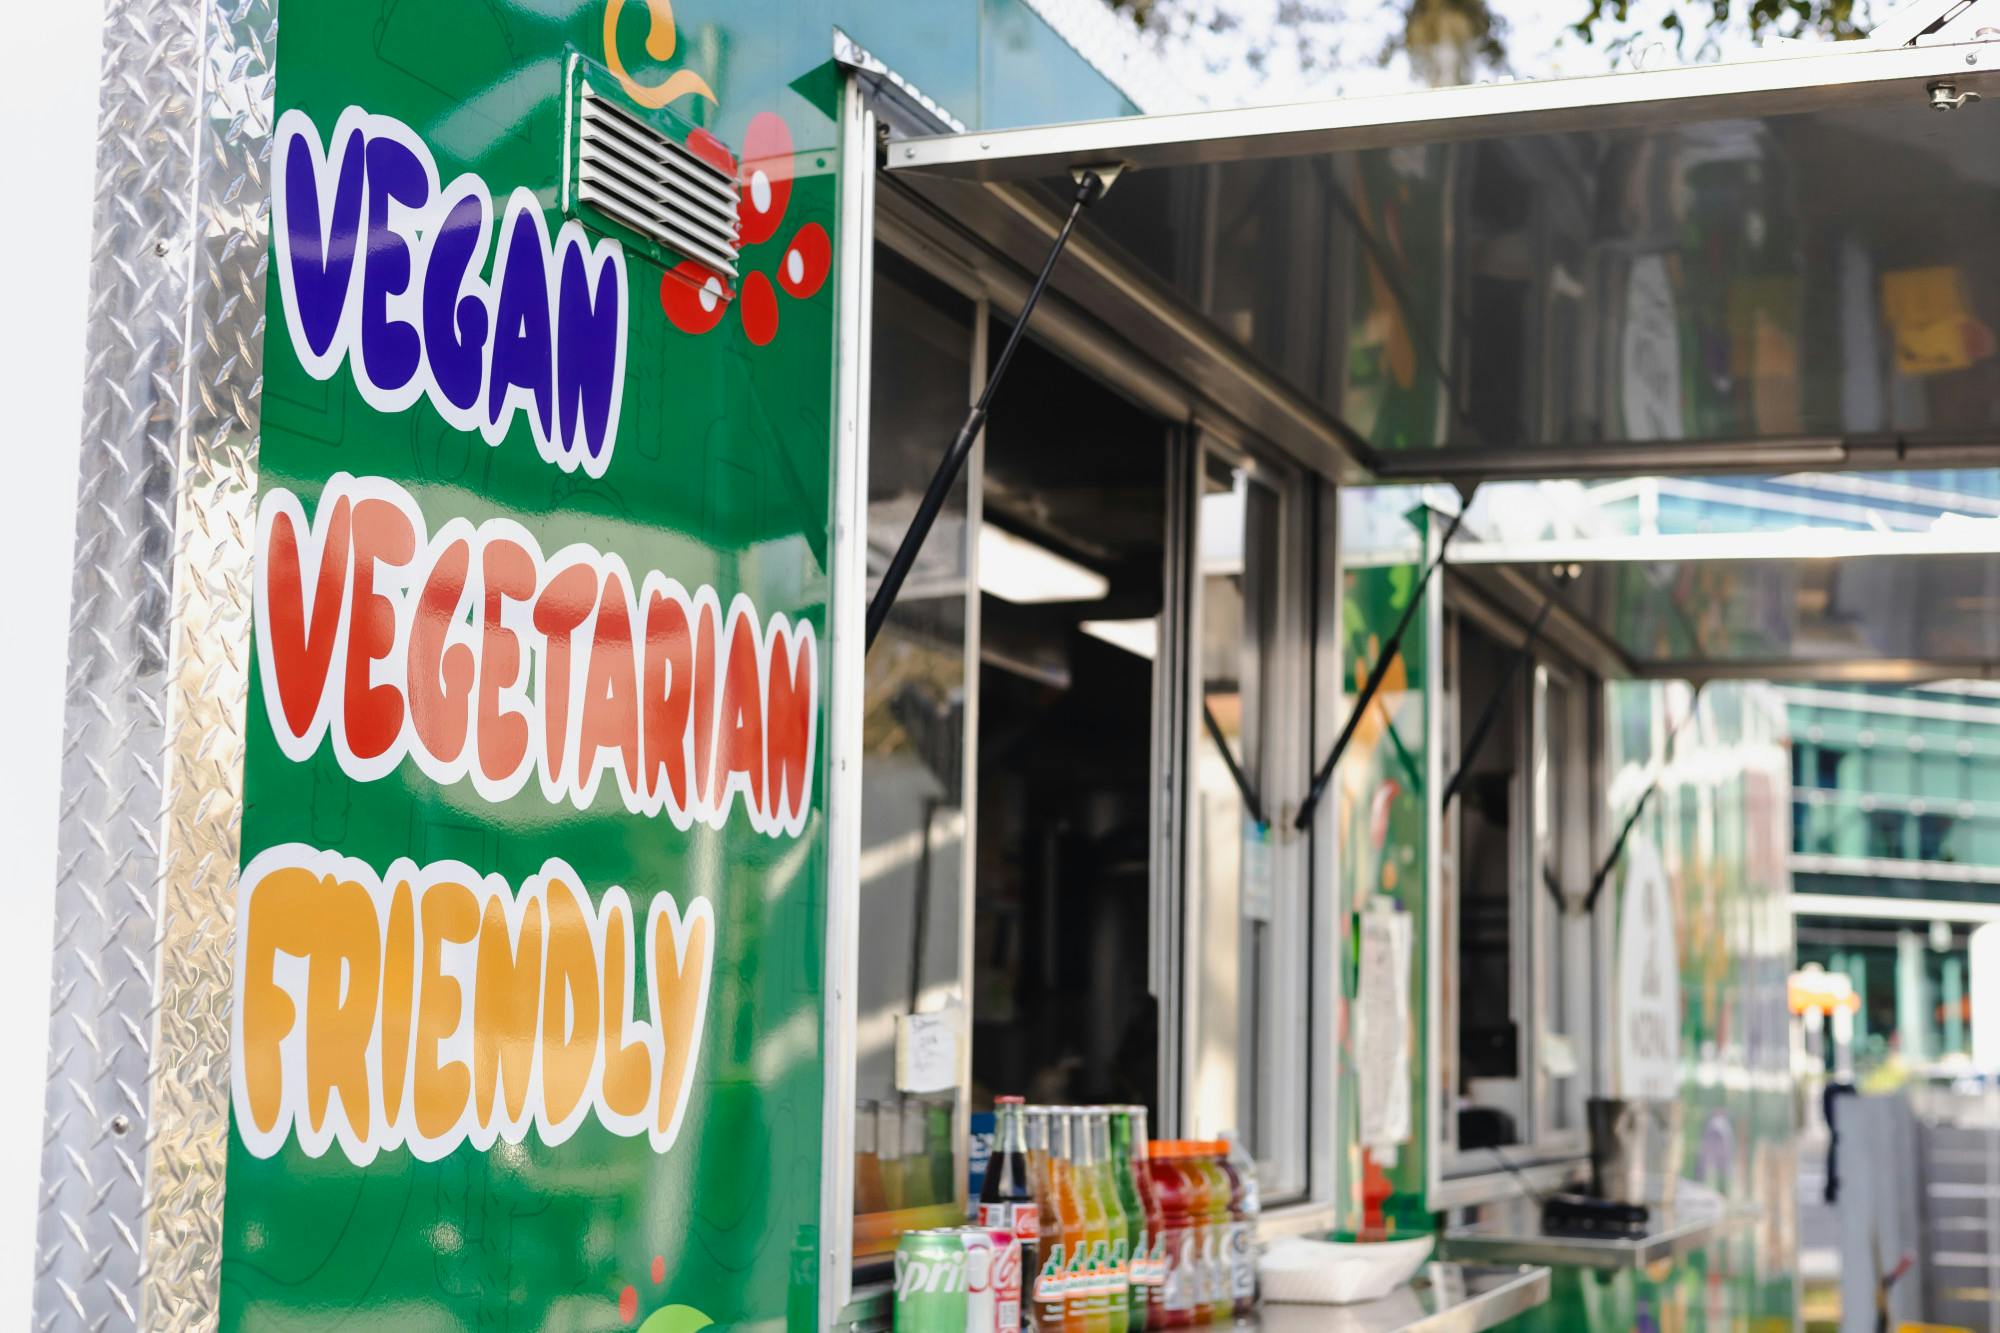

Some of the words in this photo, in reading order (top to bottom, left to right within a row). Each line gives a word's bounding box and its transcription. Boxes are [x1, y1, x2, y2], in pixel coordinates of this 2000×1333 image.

[282, 122, 623, 464] VEGAN
[263, 490, 813, 825] VEGETARIAN
[239, 863, 709, 1146] FRIENDLY
